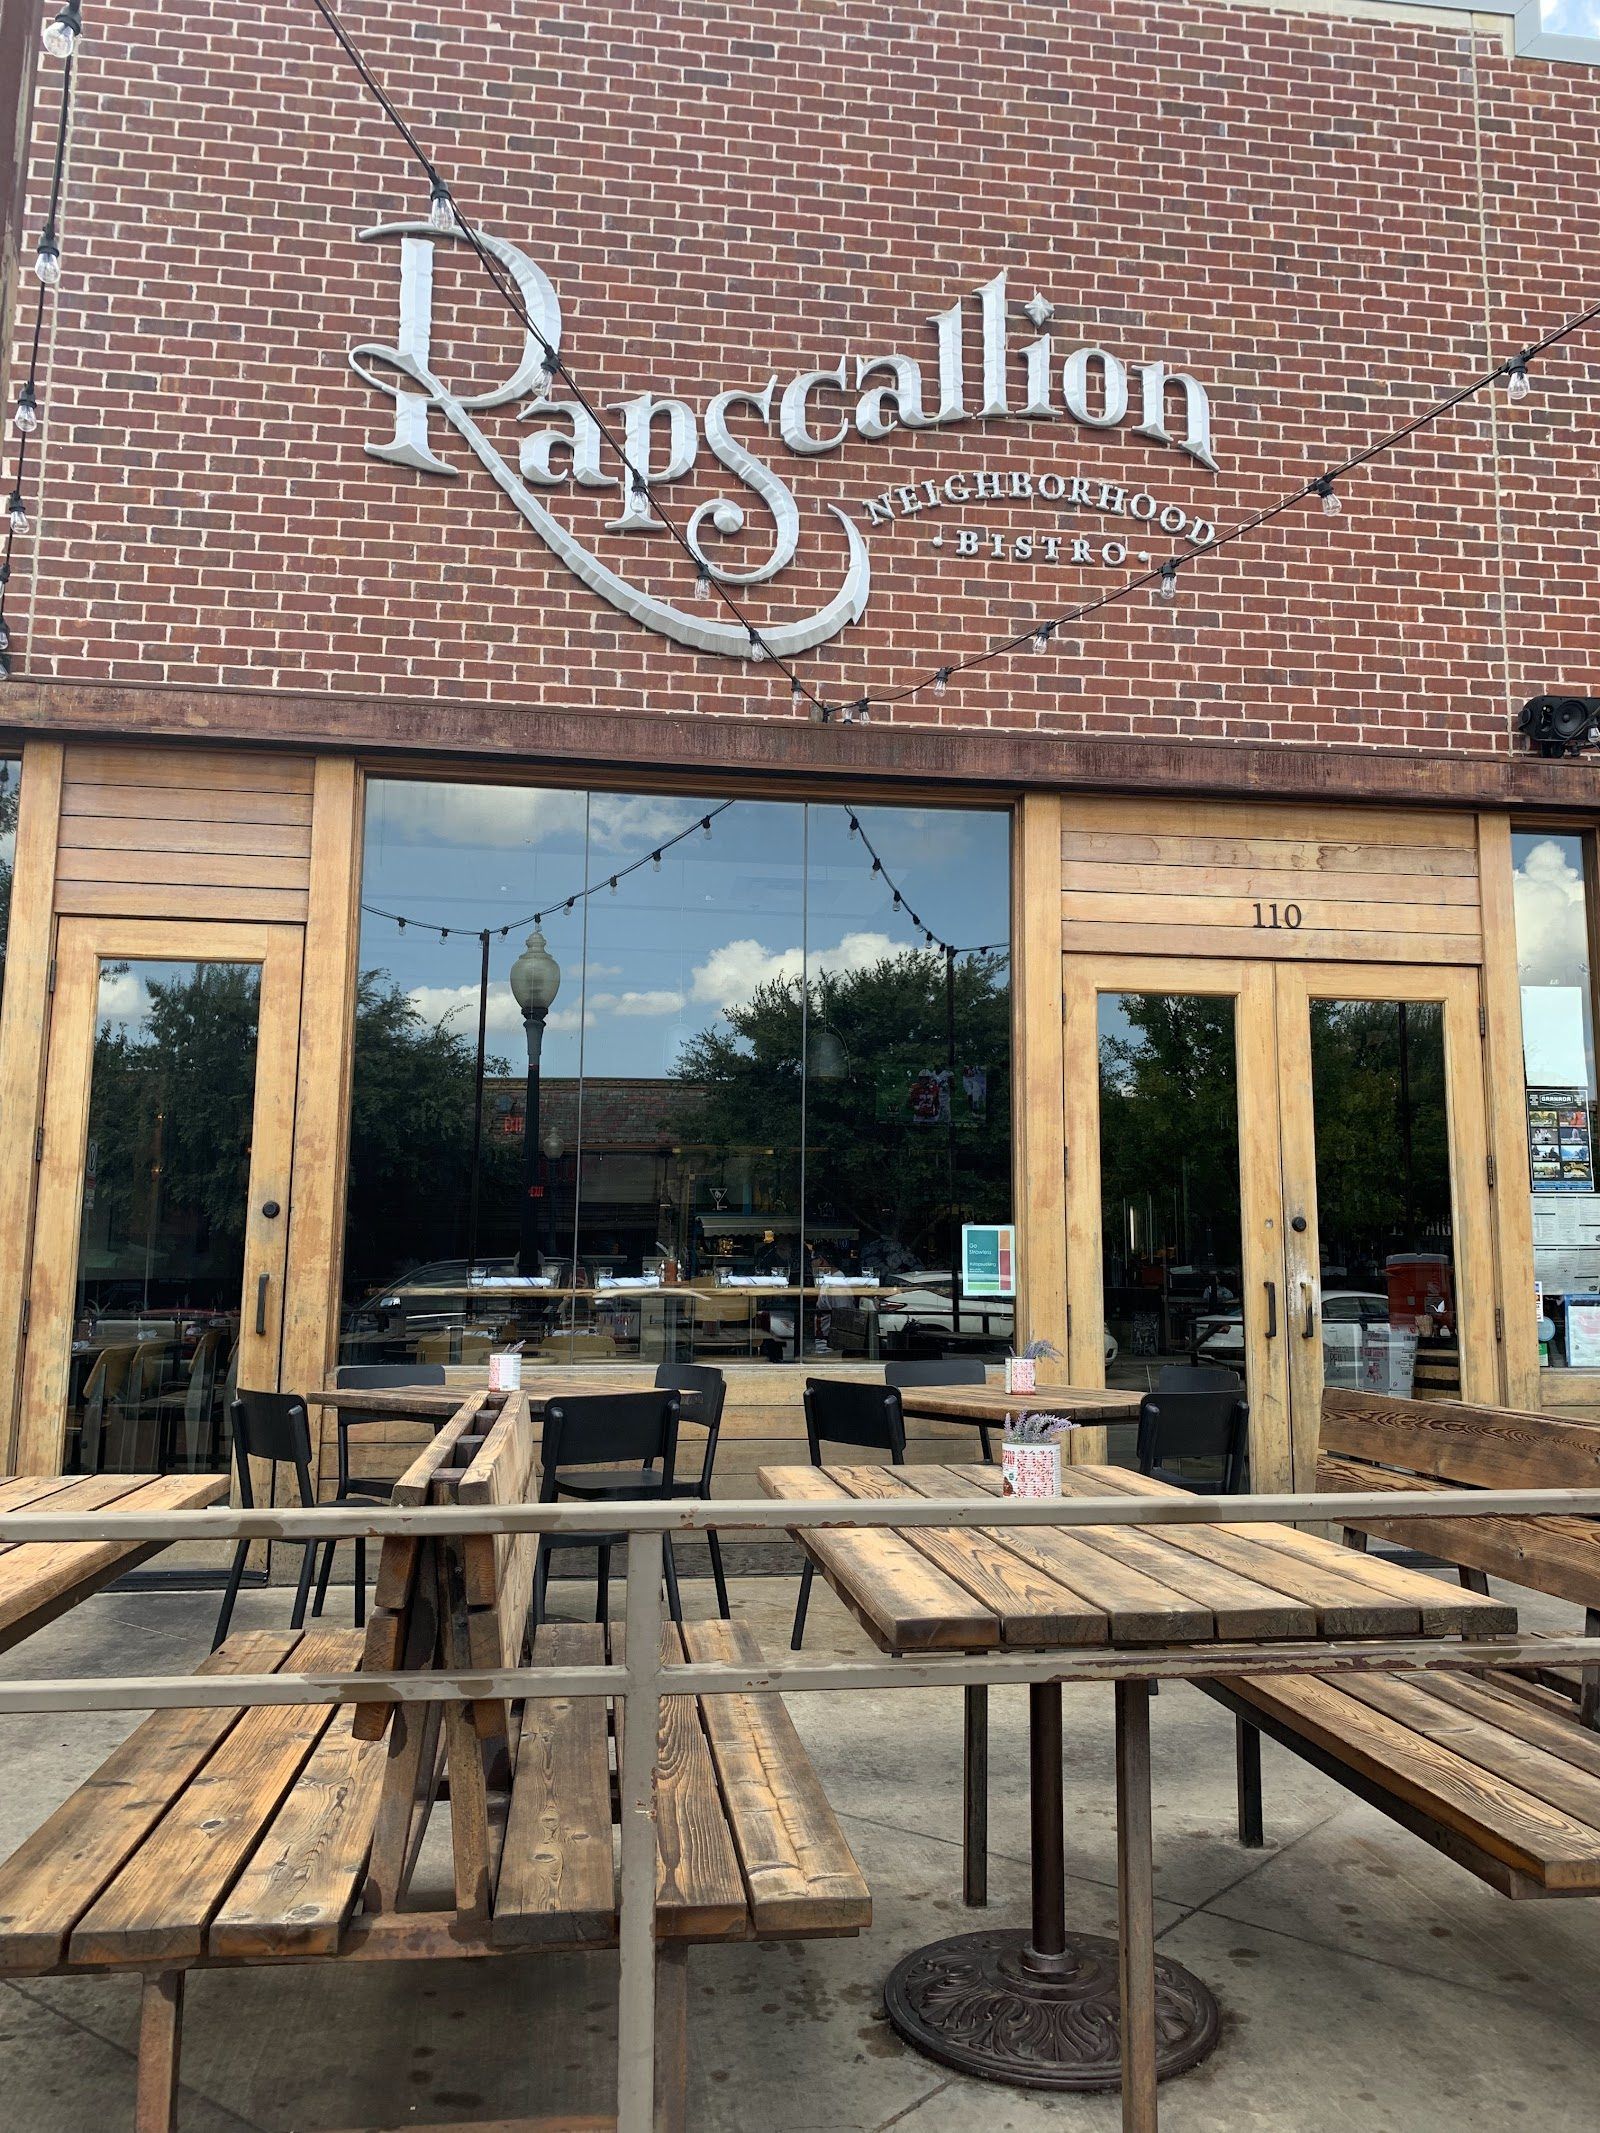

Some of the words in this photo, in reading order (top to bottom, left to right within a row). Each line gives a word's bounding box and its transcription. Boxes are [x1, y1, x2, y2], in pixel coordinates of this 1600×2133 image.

[348, 220, 1221, 659] Rapscallion
[861, 470, 1217, 548] NEIGHBORHOOD
[955, 530, 1127, 567] BISTRO
[1252, 902, 1302, 929] 110
[504, 1116, 523, 1132] EXIT
[529, 1186, 545, 1197] EXIT
